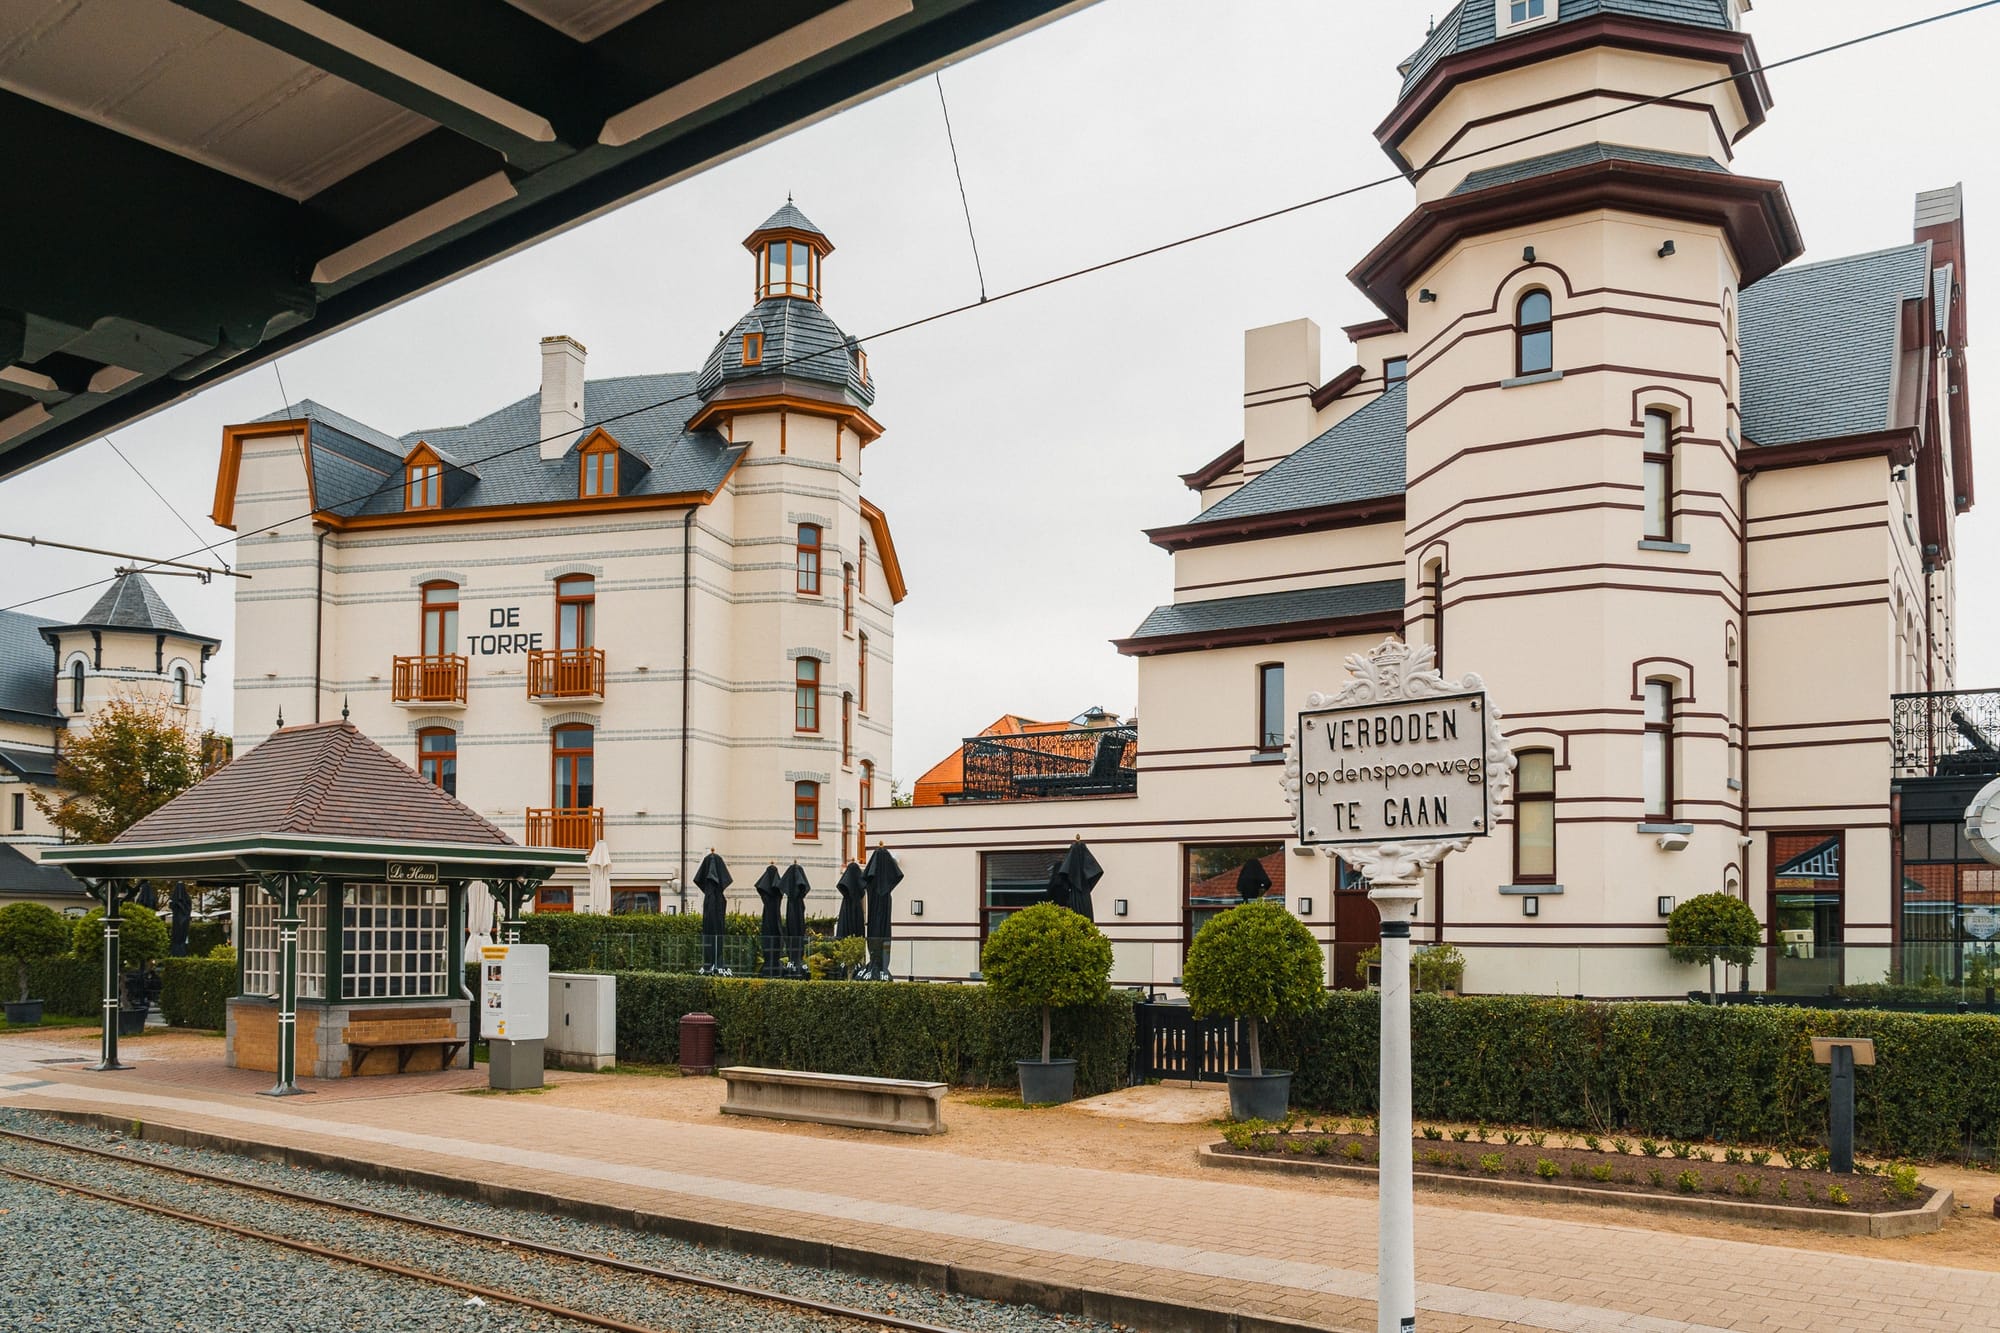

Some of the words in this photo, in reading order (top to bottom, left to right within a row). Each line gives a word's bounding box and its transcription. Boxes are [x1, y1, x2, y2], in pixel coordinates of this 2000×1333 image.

[490, 607, 520, 628] DE
[467, 633, 543, 655] TORRE
[1326, 708, 1458, 751] VERBODEN
[1333, 801, 1362, 832] TE
[1384, 796, 1449, 828] GAAN
[390, 863, 405, 879] De
[406, 865, 435, 880] Haan
